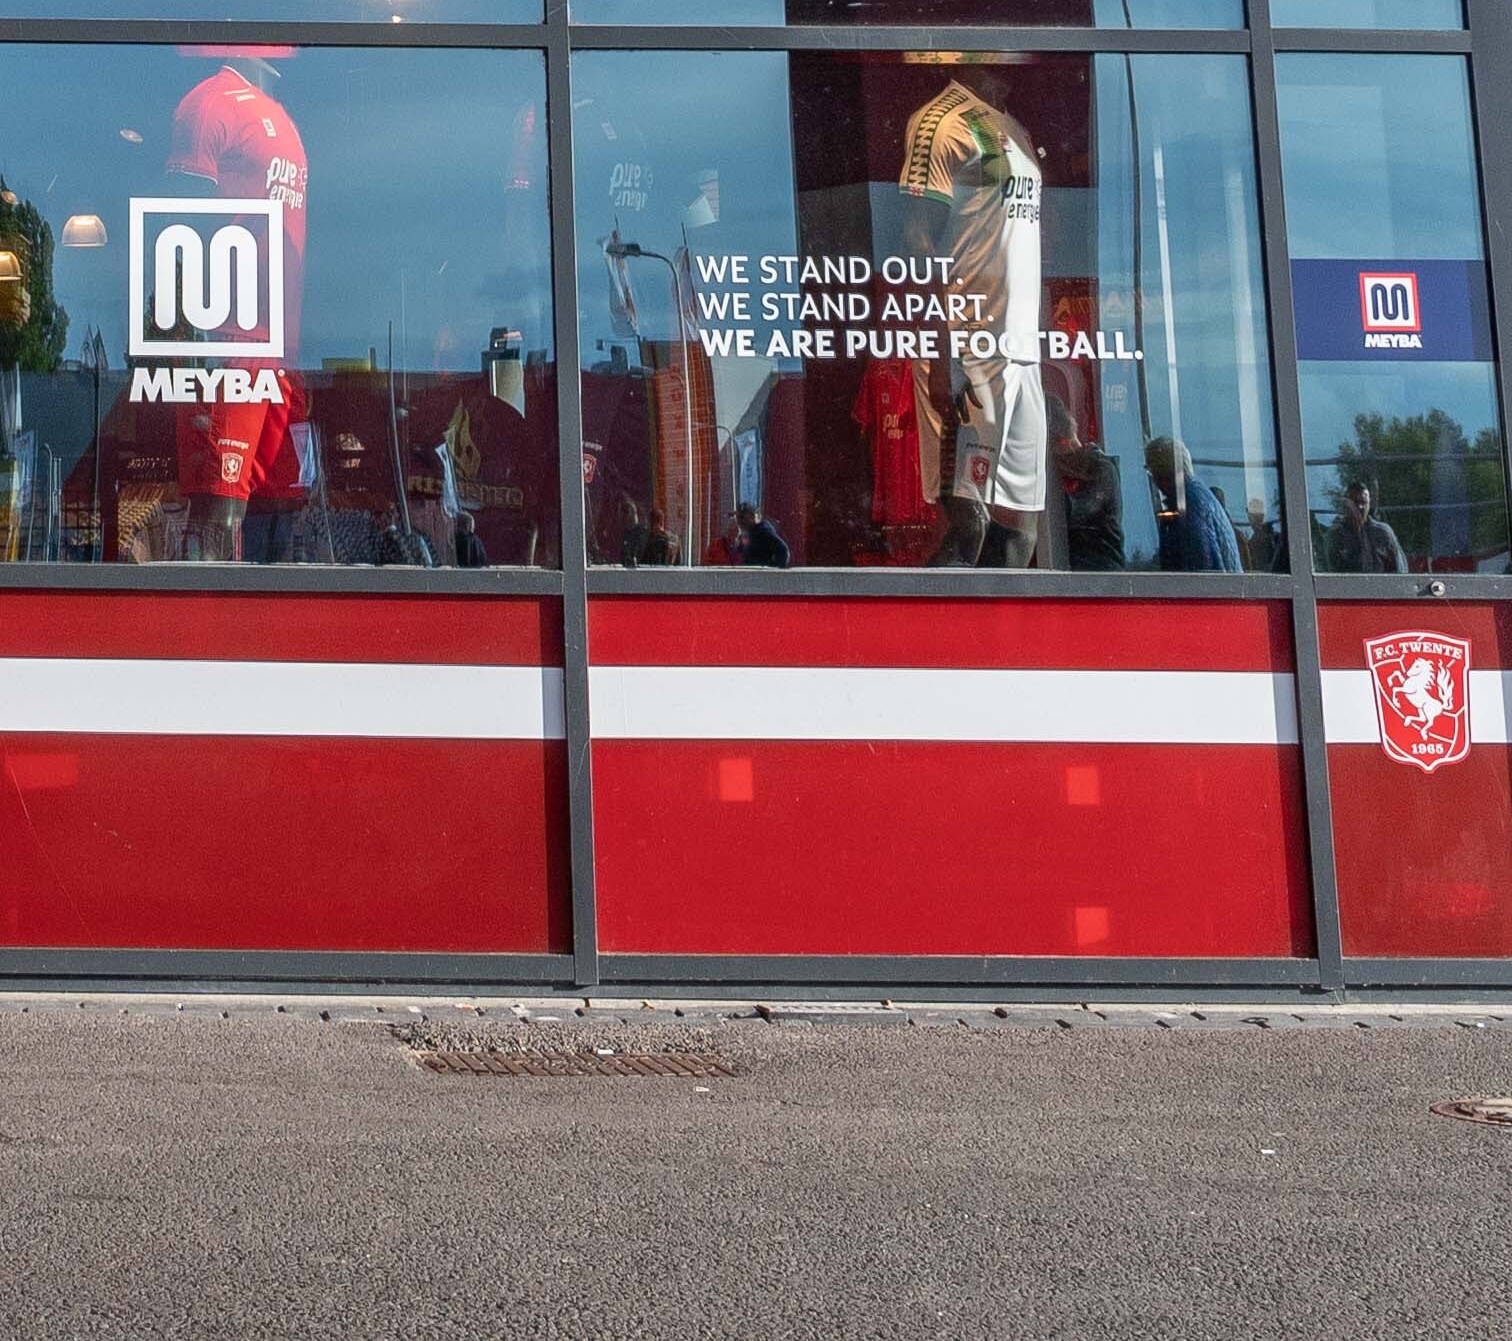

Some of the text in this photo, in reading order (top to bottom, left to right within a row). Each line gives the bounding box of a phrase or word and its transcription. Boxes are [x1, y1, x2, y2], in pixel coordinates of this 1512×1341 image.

[696, 255, 964, 286] WE STAND OUT.
[697, 292, 995, 322] WE STAND APART.
[699, 329, 755, 357] WE
[765, 329, 835, 358] ARE
[846, 330, 940, 359] PURE
[1364, 333, 1423, 348] MEYBA
[128, 367, 285, 404] MEYBA
[1399, 641, 1463, 659] TWENTE
[1411, 743, 1444, 754] 1965
